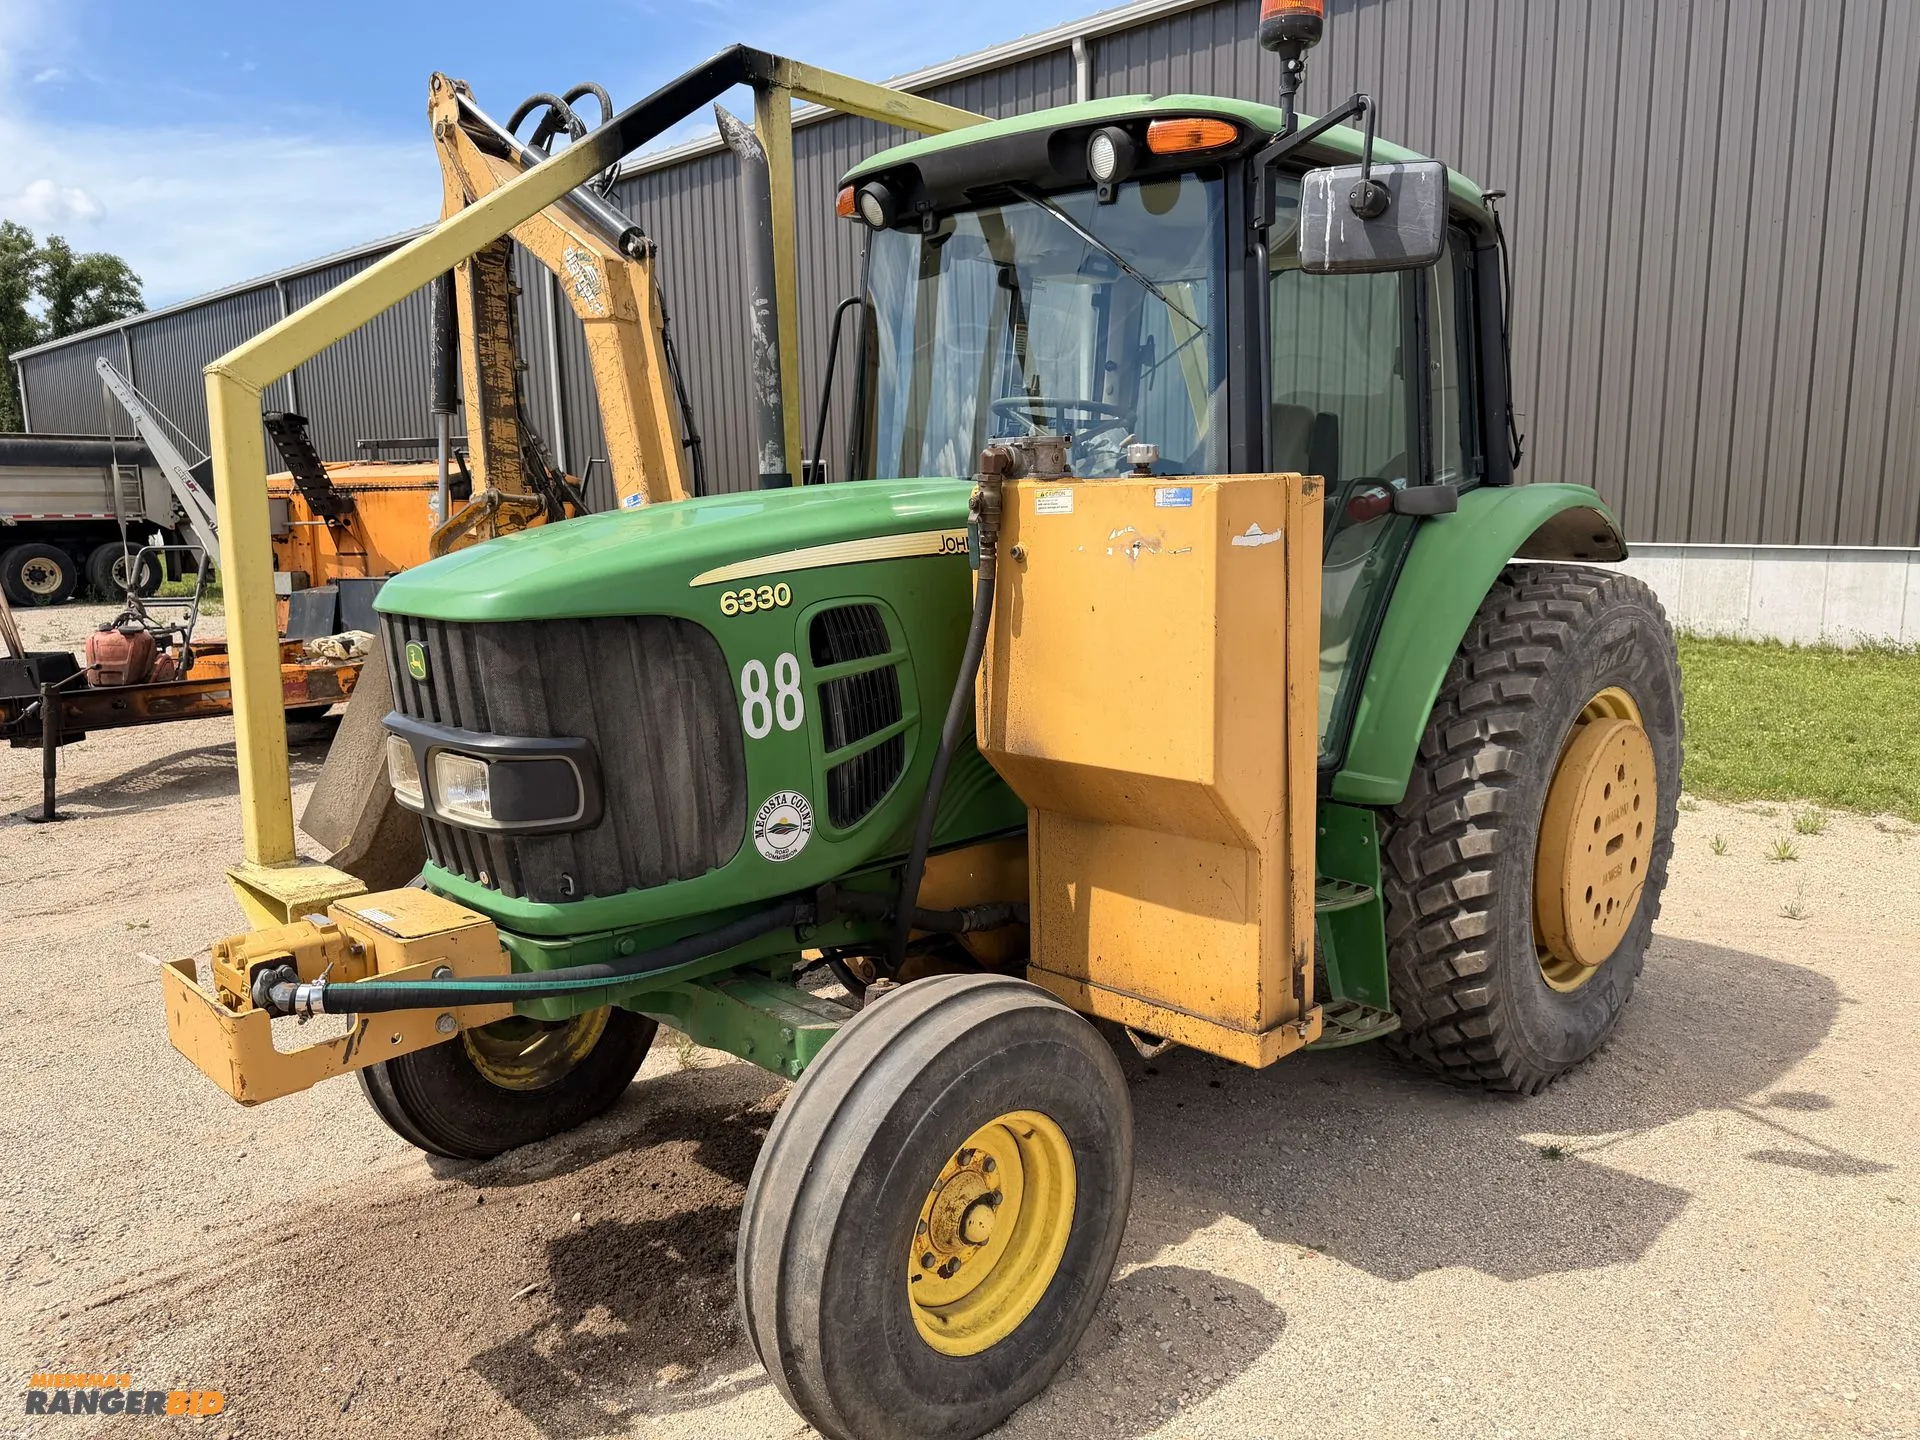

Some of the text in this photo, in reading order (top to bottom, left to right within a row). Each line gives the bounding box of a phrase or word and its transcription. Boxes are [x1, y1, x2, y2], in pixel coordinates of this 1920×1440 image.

[720, 582, 792, 617] 6330
[741, 652, 804, 739] 88
[755, 794, 812, 839] MECOSTA COUNTY
[765, 848, 798, 860] COMMISSION
